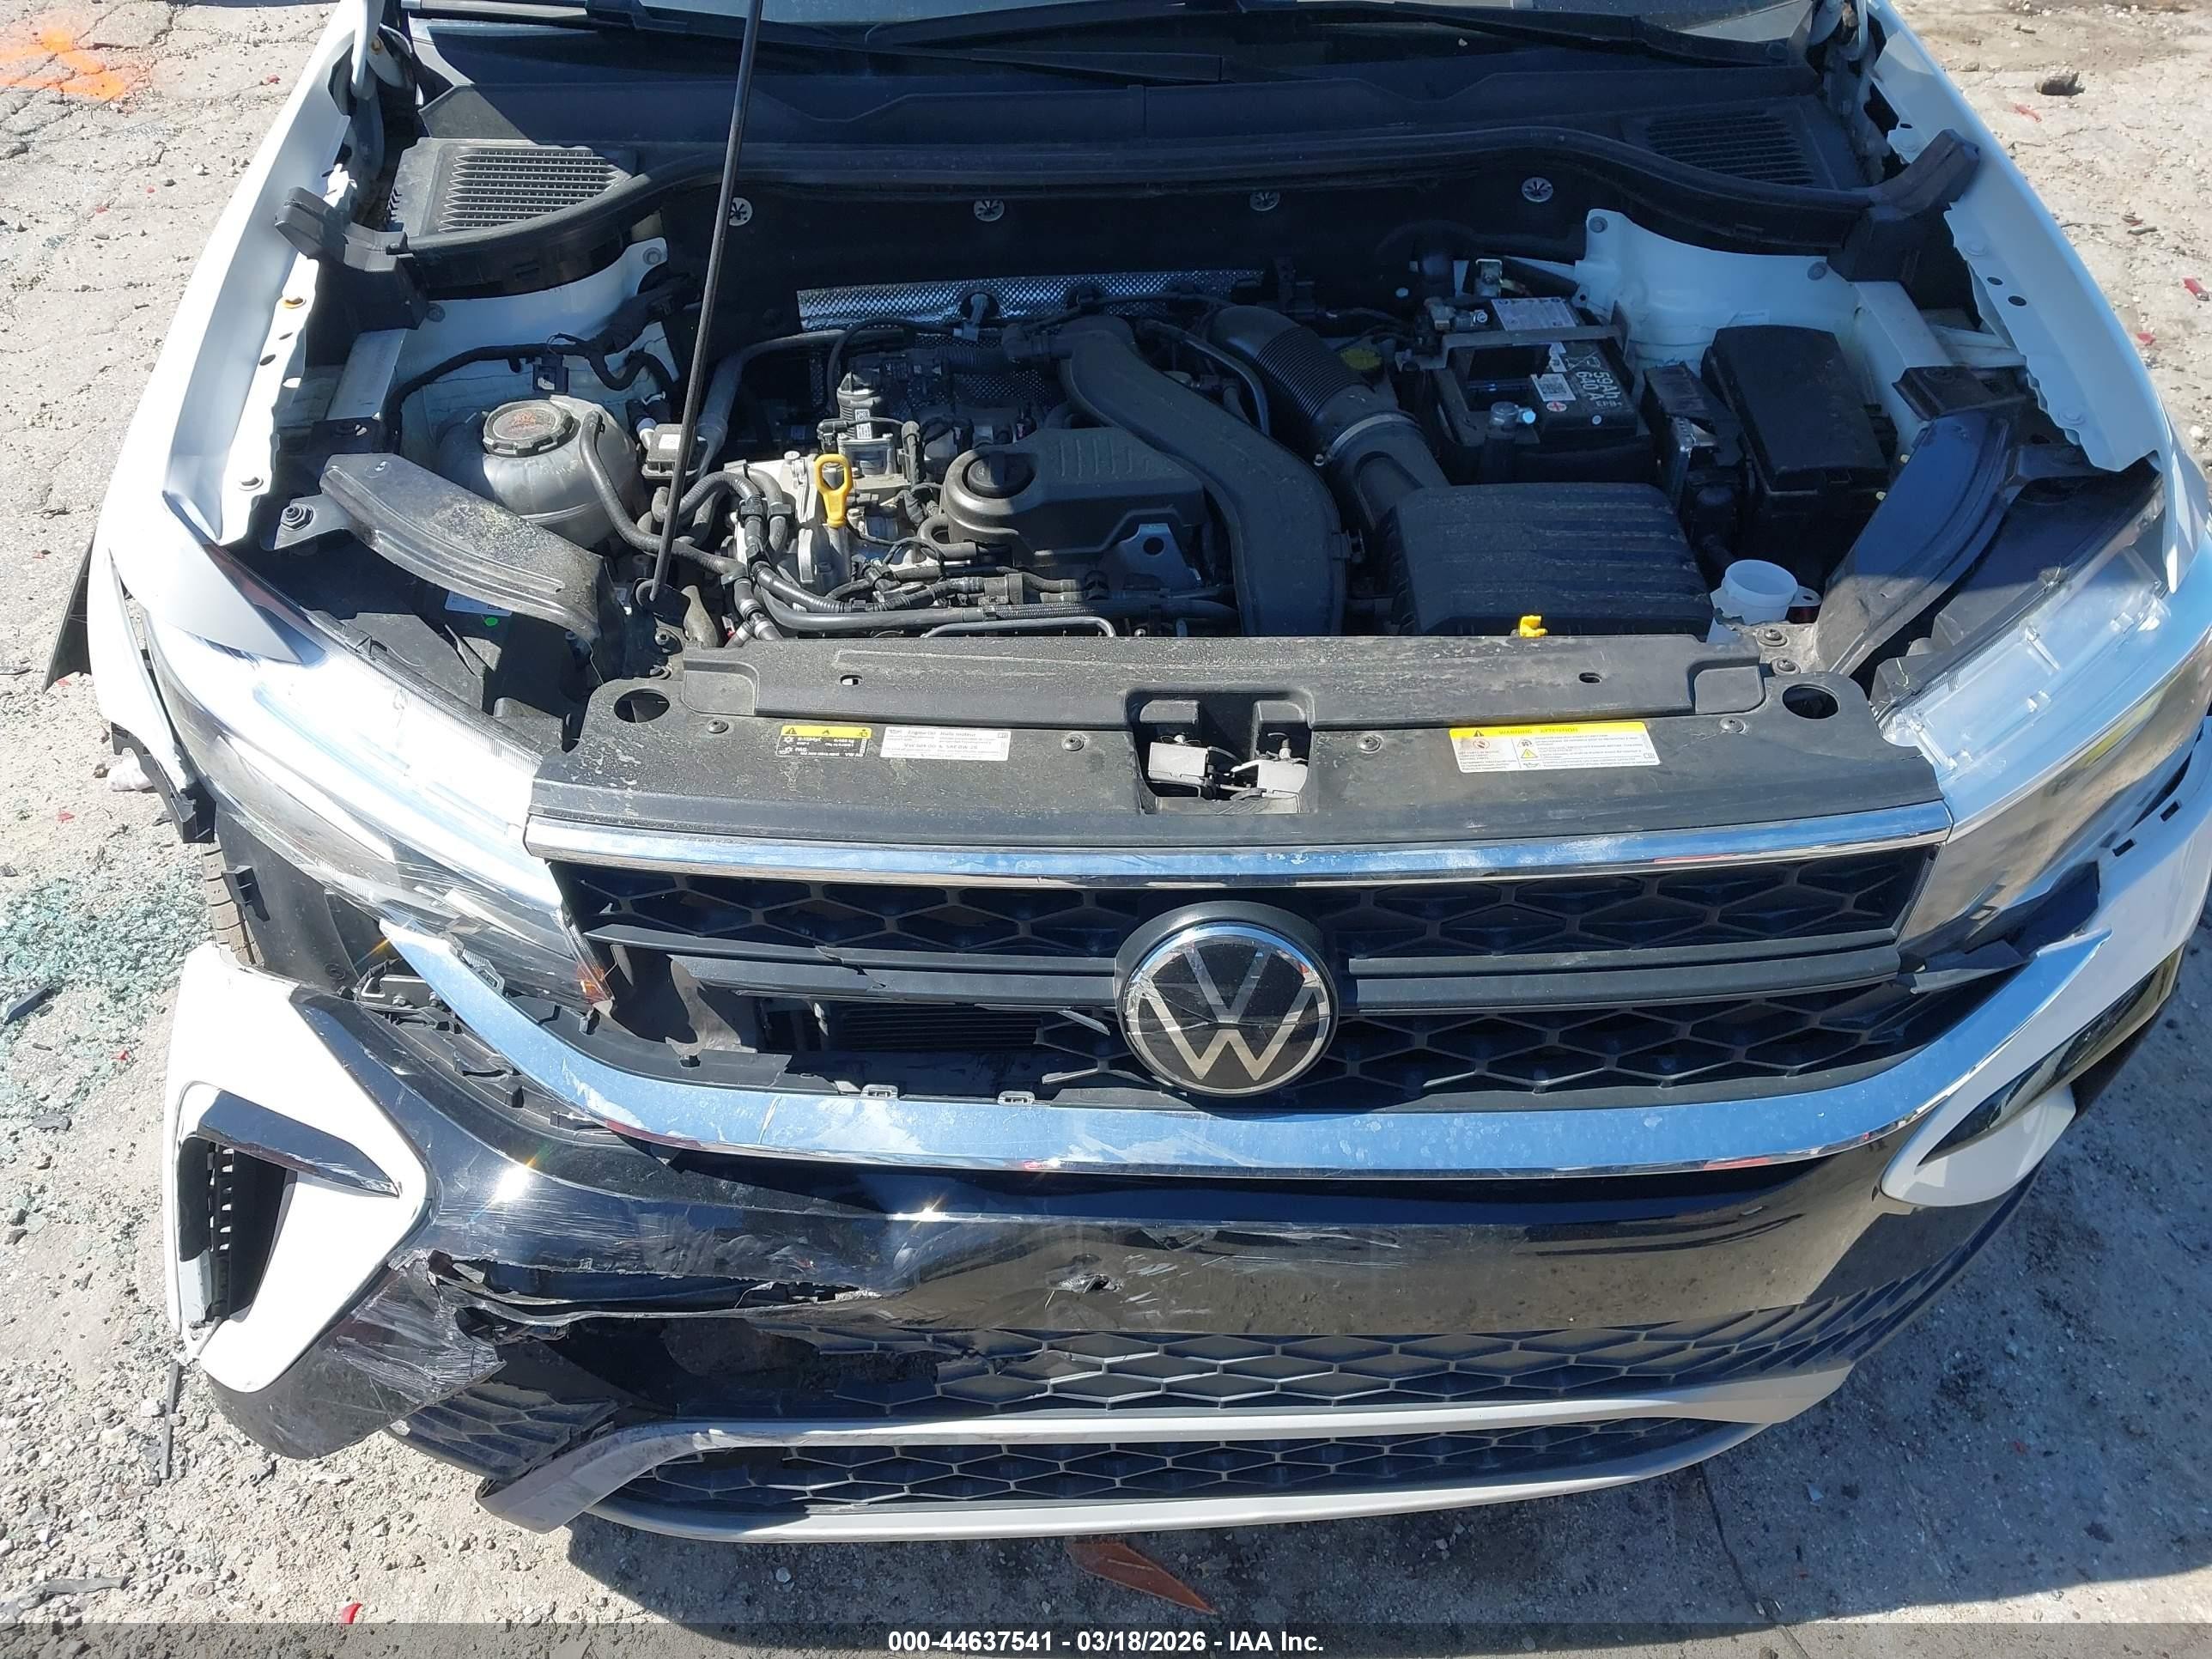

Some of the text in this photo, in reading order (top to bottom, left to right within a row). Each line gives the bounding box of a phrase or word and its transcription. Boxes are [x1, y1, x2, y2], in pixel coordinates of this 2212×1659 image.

[1575, 371, 1605, 401] 640 A
[1593, 371, 1621, 399] 59Ah
[1133, 938, 1322, 1084] VW
